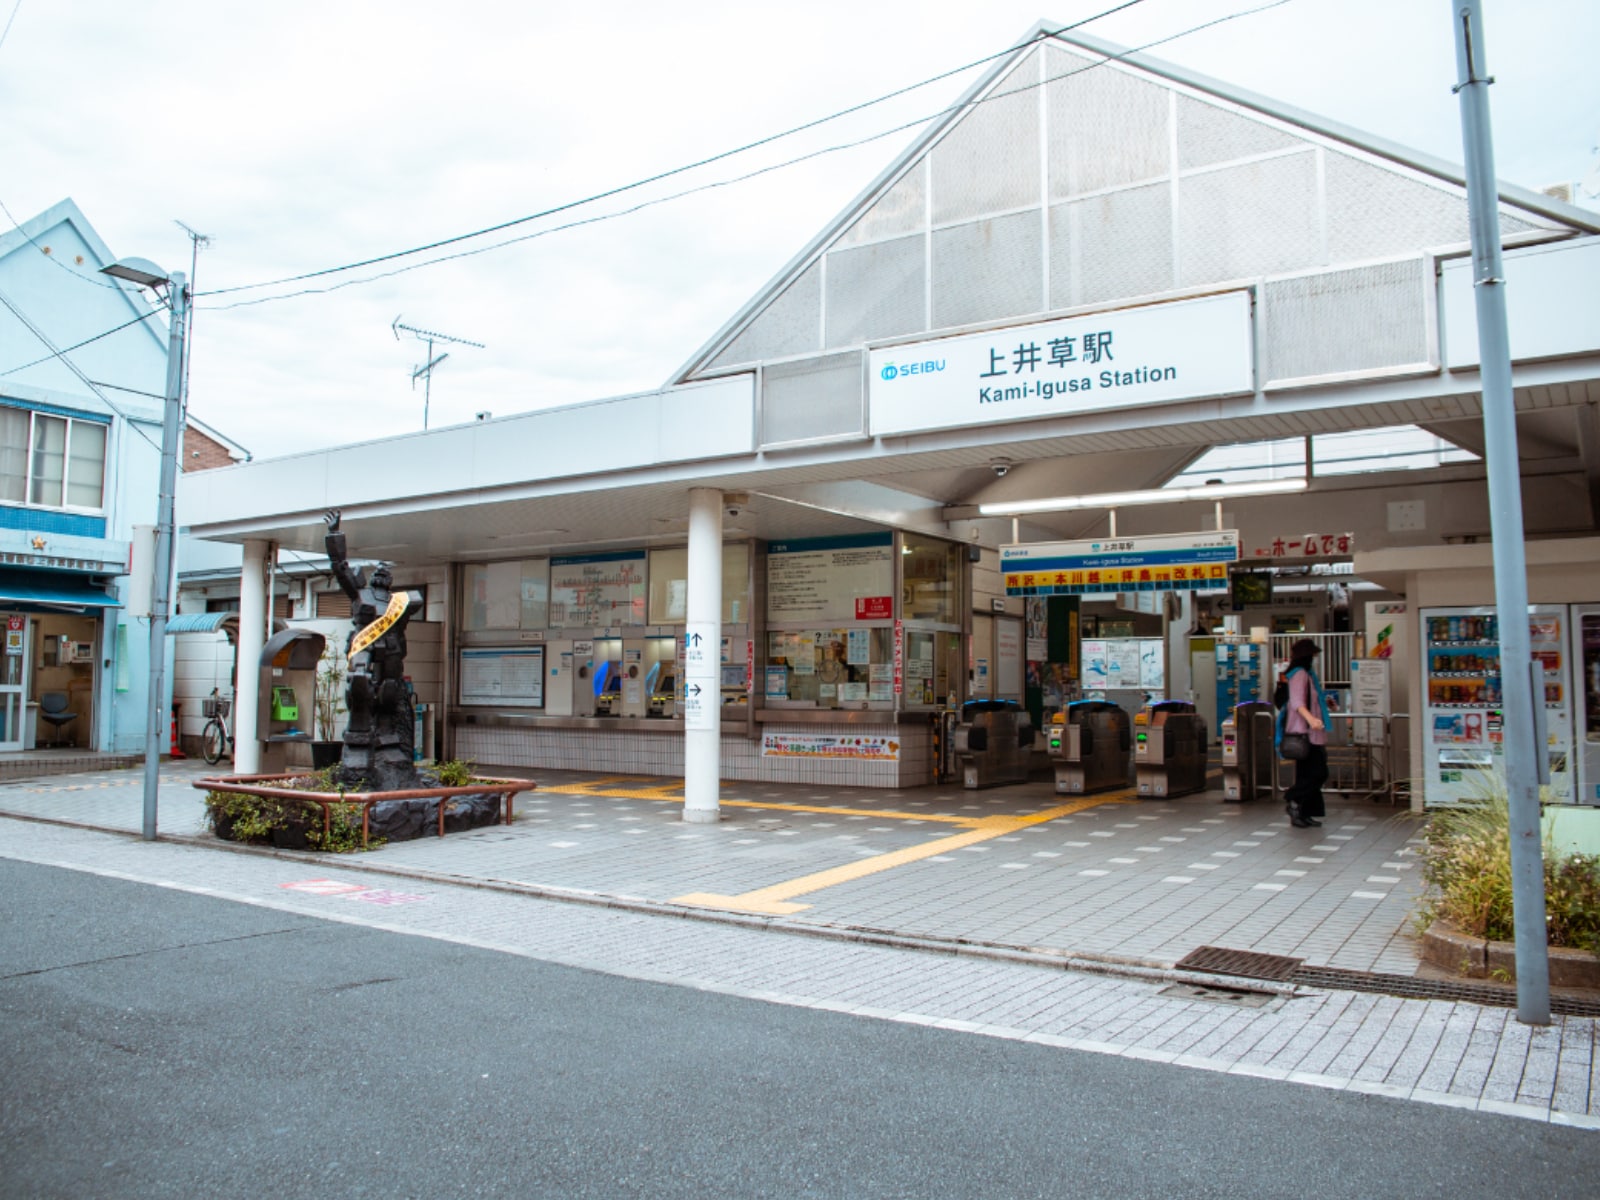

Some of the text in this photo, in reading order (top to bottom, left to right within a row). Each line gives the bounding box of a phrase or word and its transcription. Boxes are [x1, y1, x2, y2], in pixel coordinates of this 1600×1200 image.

[900, 359, 946, 377] SEIBU
[979, 331, 1114, 379] 上井草駅
[979, 364, 1177, 403] Kami-Igusa Station
[1272, 535, 1350, 557] ホームです
